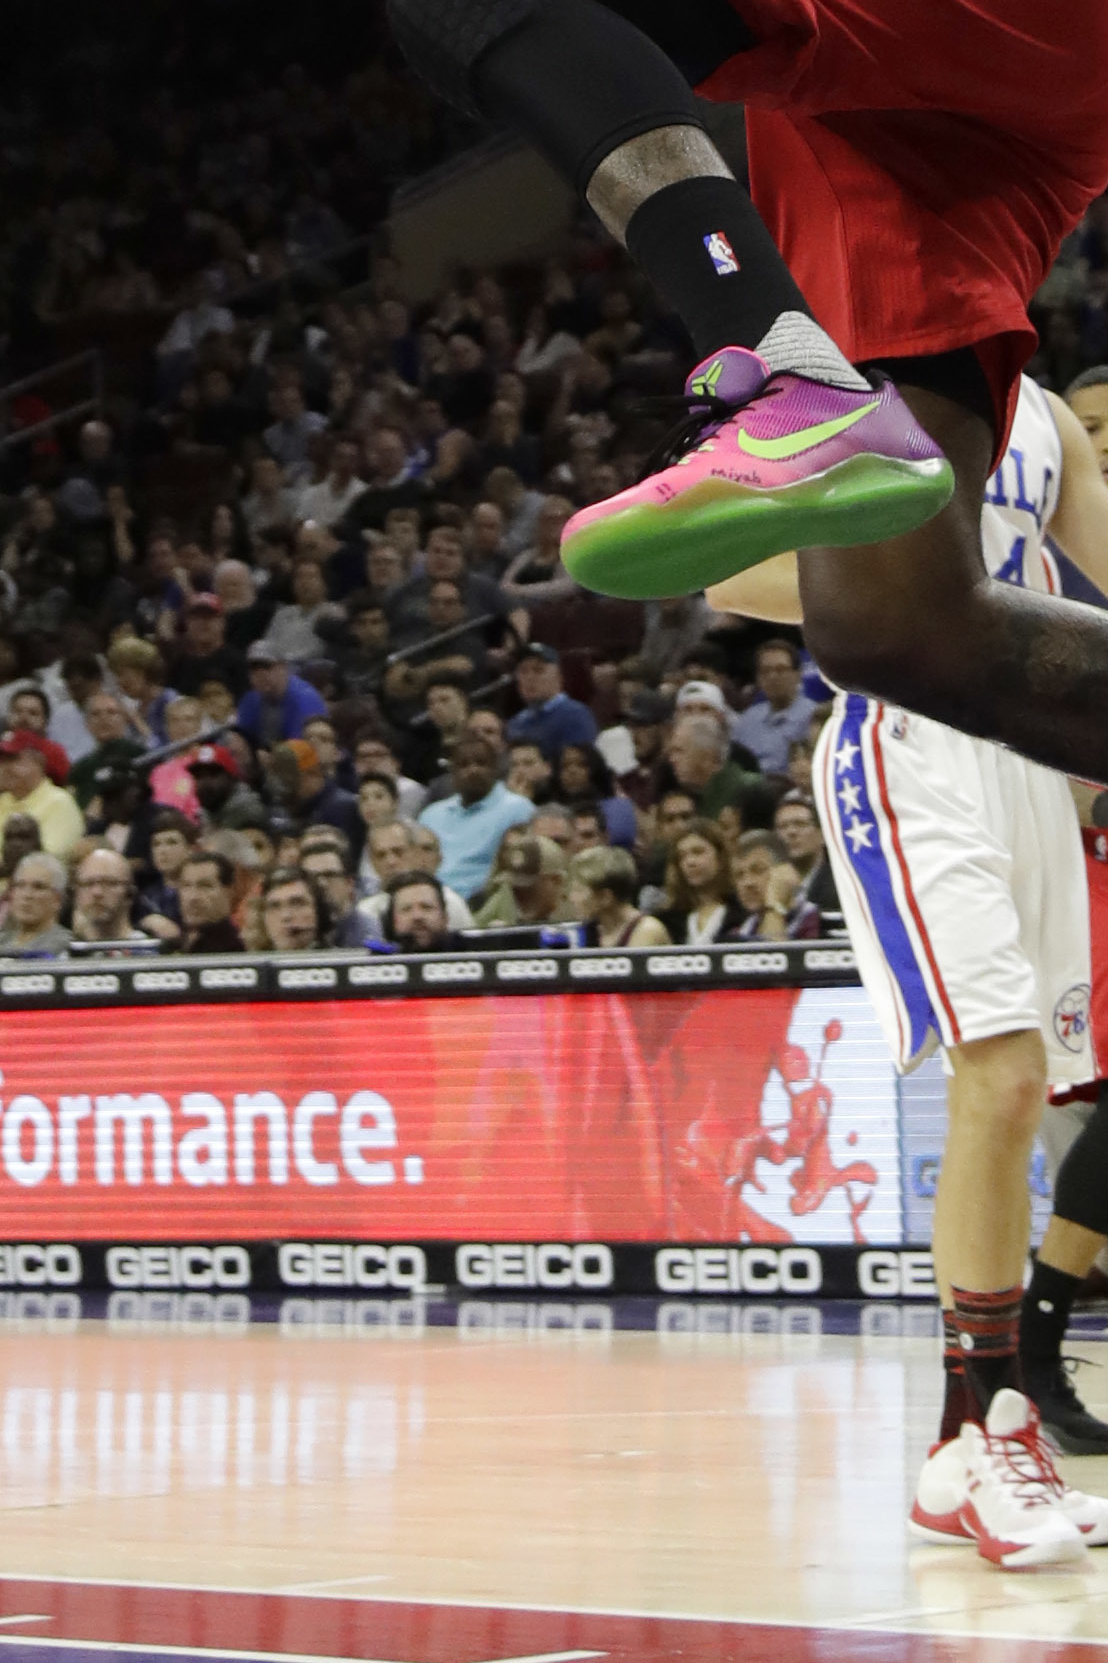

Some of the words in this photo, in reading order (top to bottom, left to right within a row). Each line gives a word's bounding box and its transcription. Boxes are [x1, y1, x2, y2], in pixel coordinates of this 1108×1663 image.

[200, 967, 259, 988] GEICO
[278, 967, 338, 988] GEICO
[348, 964, 409, 985] GEICO
[422, 961, 484, 981] GEICO
[496, 959, 558, 979] GEICO
[569, 956, 632, 977] GEICO
[647, 954, 711, 975] GEICO
[723, 952, 789, 973] GEICO
[805, 949, 857, 970] GEIC
[0, 1089, 425, 1187] ormance.
[0, 1244, 83, 1287] ICO
[105, 1245, 251, 1288] GEICO
[277, 1243, 427, 1288] GEICO
[455, 1243, 614, 1288] GEICO
[655, 1247, 823, 1294] GEICO
